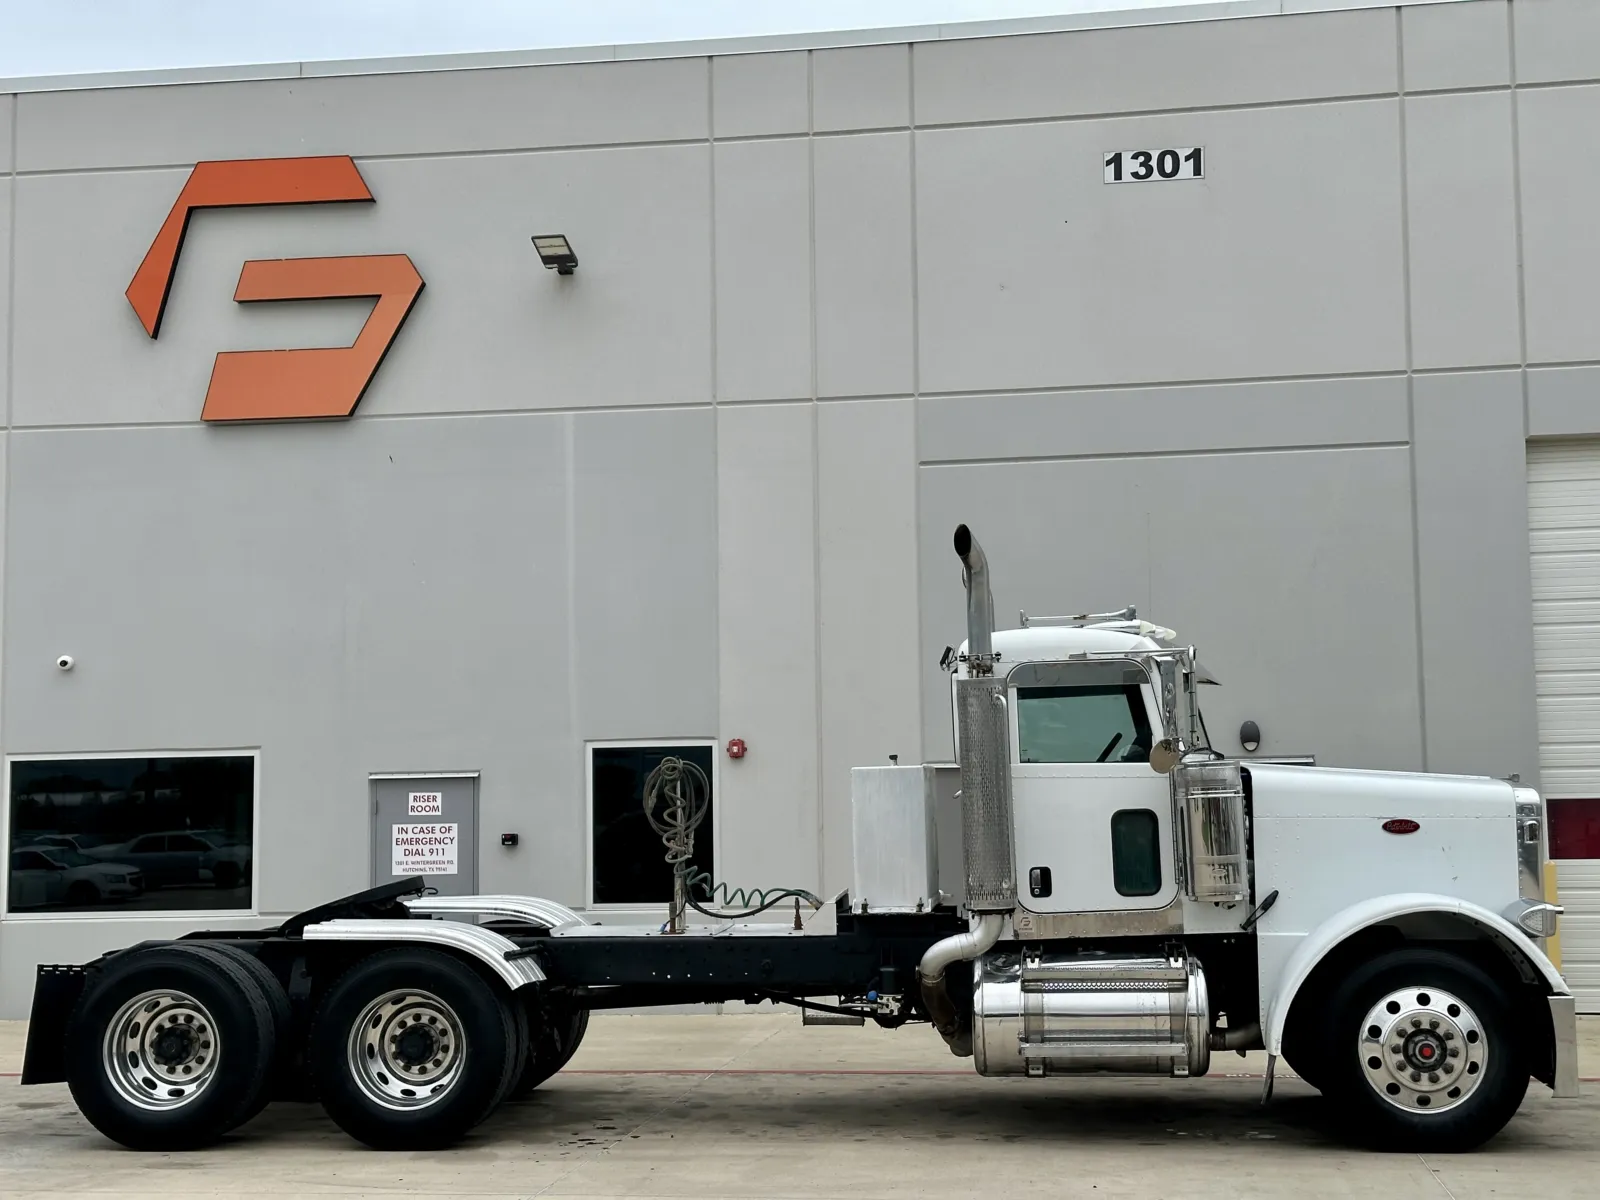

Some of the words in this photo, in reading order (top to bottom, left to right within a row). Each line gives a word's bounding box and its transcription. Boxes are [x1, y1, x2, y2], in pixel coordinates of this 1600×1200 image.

[1105, 148, 1202, 181] 1301
[413, 795, 437, 803] RISER
[410, 805, 440, 813] ROOM
[397, 827, 408, 835] IN
[439, 826, 452, 834] OF
[395, 837, 455, 846] EMERGENCY
[404, 848, 425, 857] DIAL
[429, 848, 445, 856] 911
